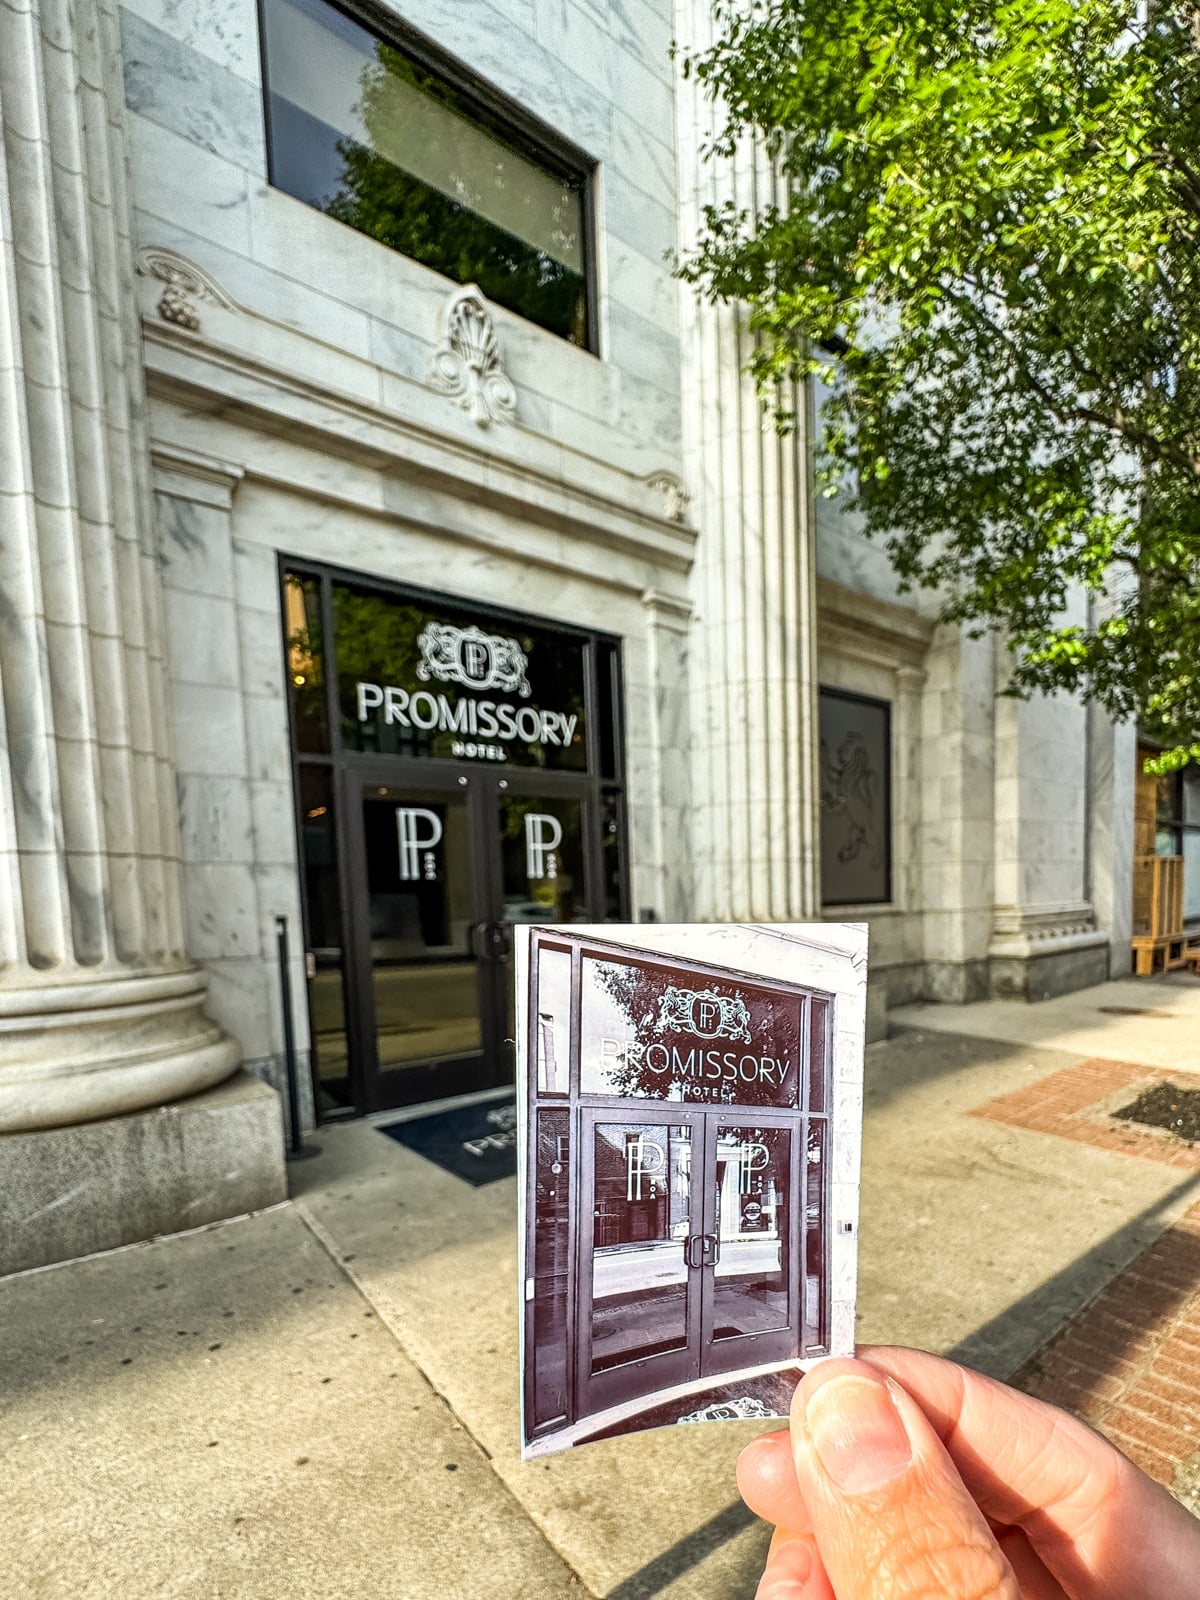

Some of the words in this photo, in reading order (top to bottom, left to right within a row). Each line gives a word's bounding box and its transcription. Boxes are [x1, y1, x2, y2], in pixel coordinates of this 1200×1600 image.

[356, 682, 577, 748] PROMISSORY
[452, 741, 507, 760] HOTEL
[600, 1037, 791, 1085] PROMISSORY
[682, 1085, 727, 1098] HOTEL
